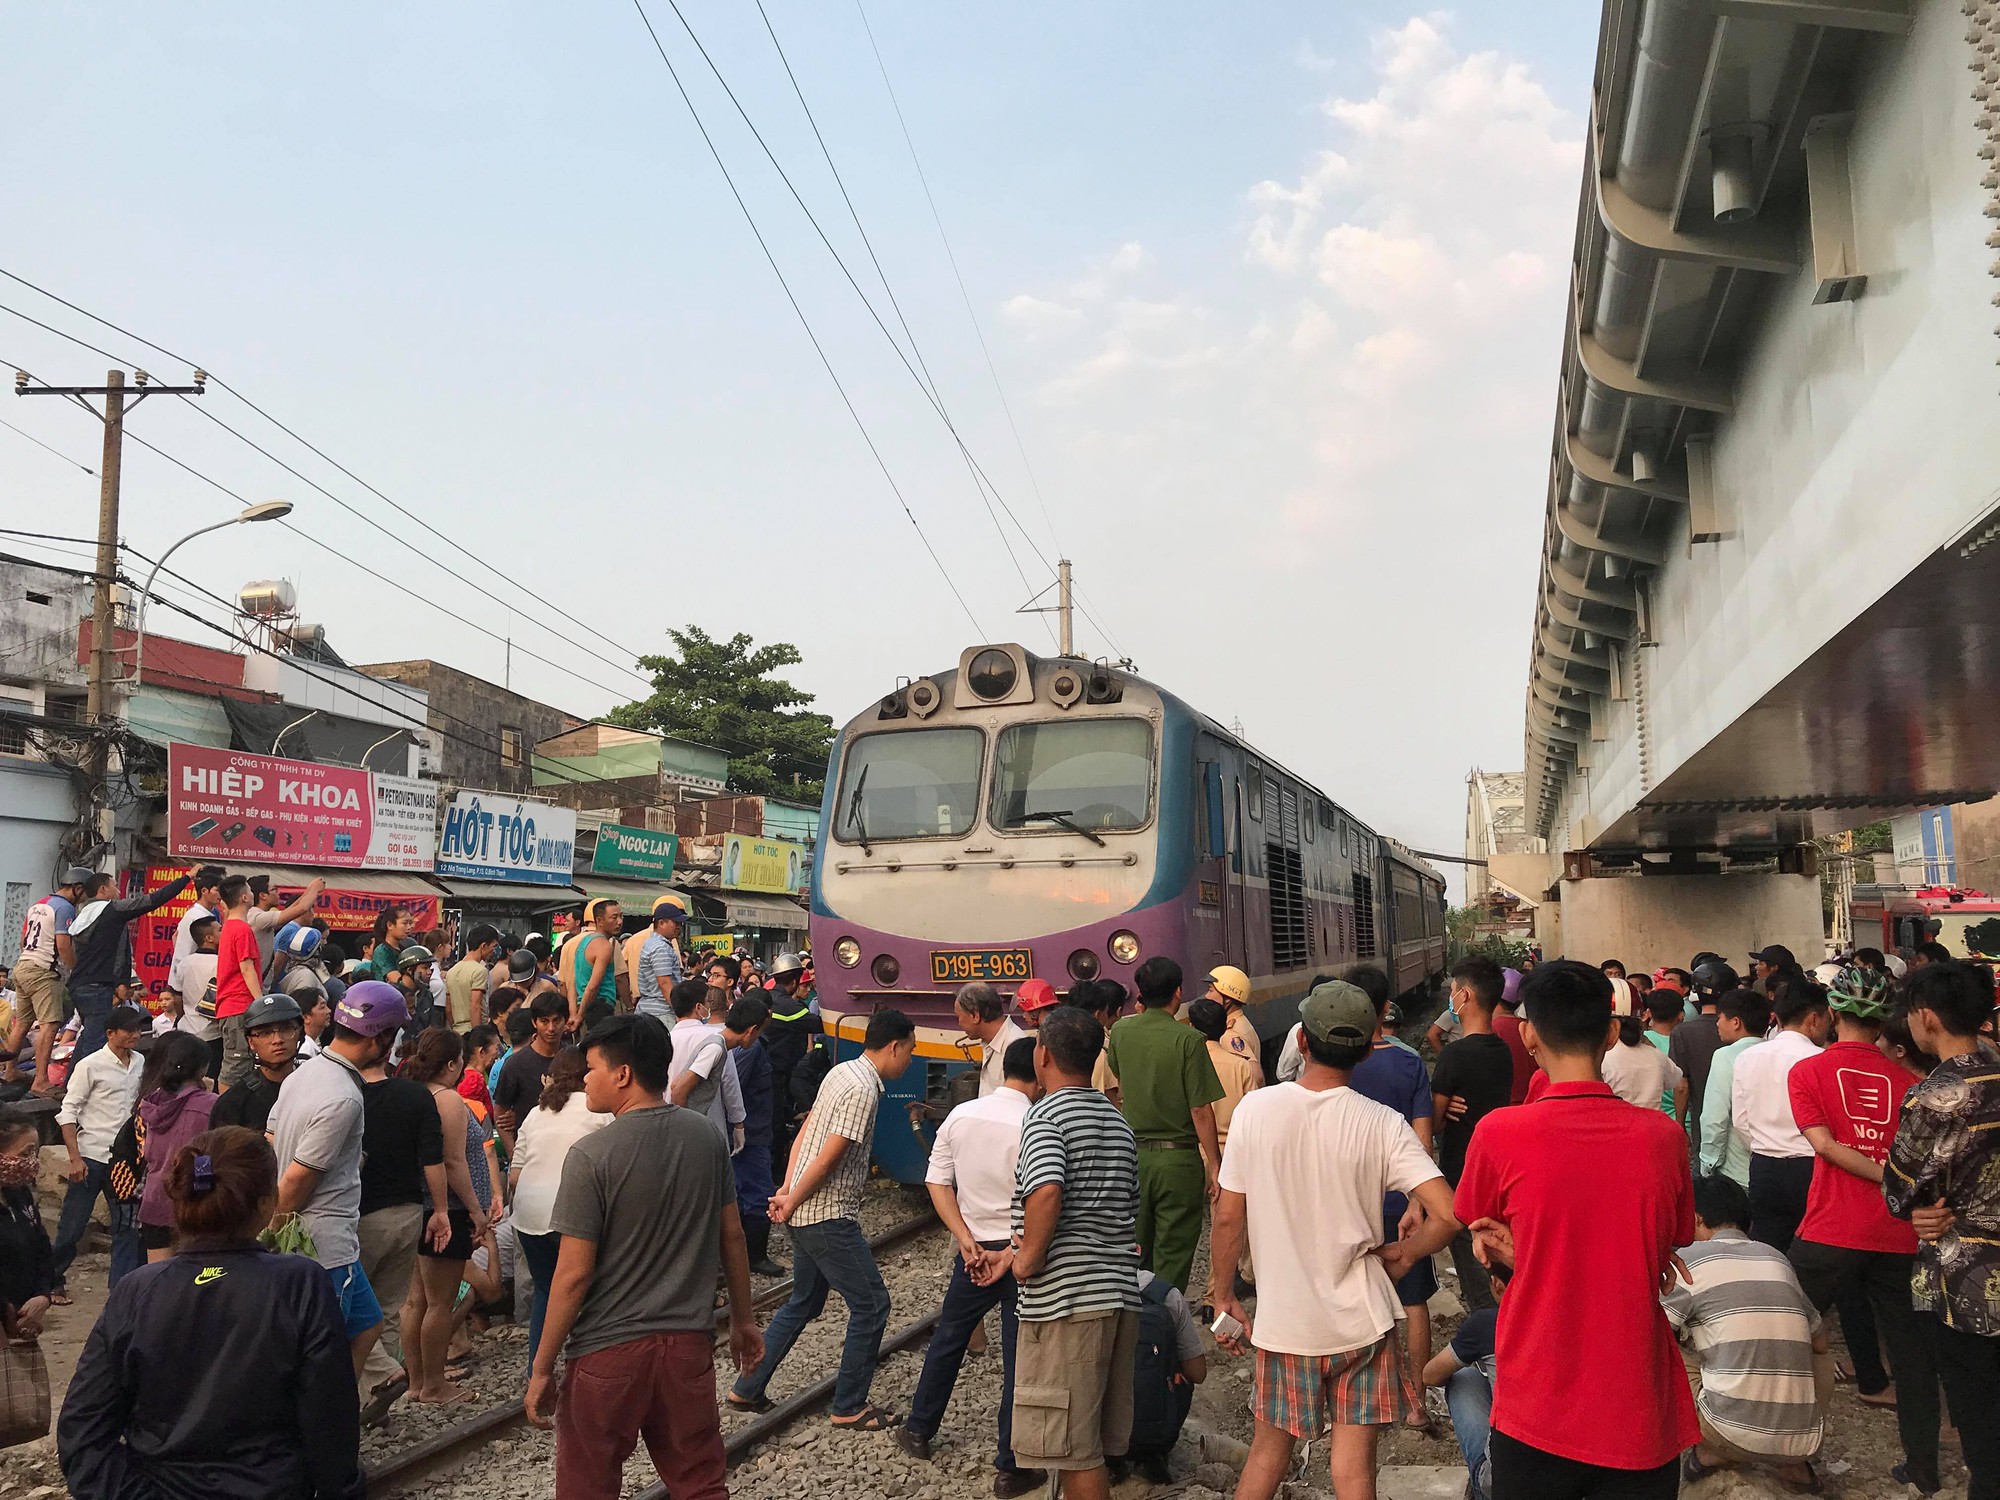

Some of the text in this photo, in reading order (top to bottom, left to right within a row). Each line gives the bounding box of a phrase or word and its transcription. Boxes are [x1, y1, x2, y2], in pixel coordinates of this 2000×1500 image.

[230, 757, 326, 777] CÔNG TY TNHH TM DV
[183, 766, 360, 811] HIỆP KHOA
[385, 788, 436, 809] PETROVIETNAM GAS
[180, 800, 198, 811] KINH
[200, 803, 224, 814] DOANH
[226, 806, 239, 816] GAS
[246, 806, 259, 817] BẾP
[261, 810, 274, 819] GAS
[280, 812, 292, 823] PHỤ
[441, 796, 535, 866] HỚT TÓC
[600, 825, 620, 845] Shop
[388, 843, 418, 856] GỌI GAS
[649, 840, 671, 857] LAN
[767, 843, 779, 857] TÓC
[935, 953, 1028, 978] D19E-963
[200, 1266, 224, 1277] NIKE
